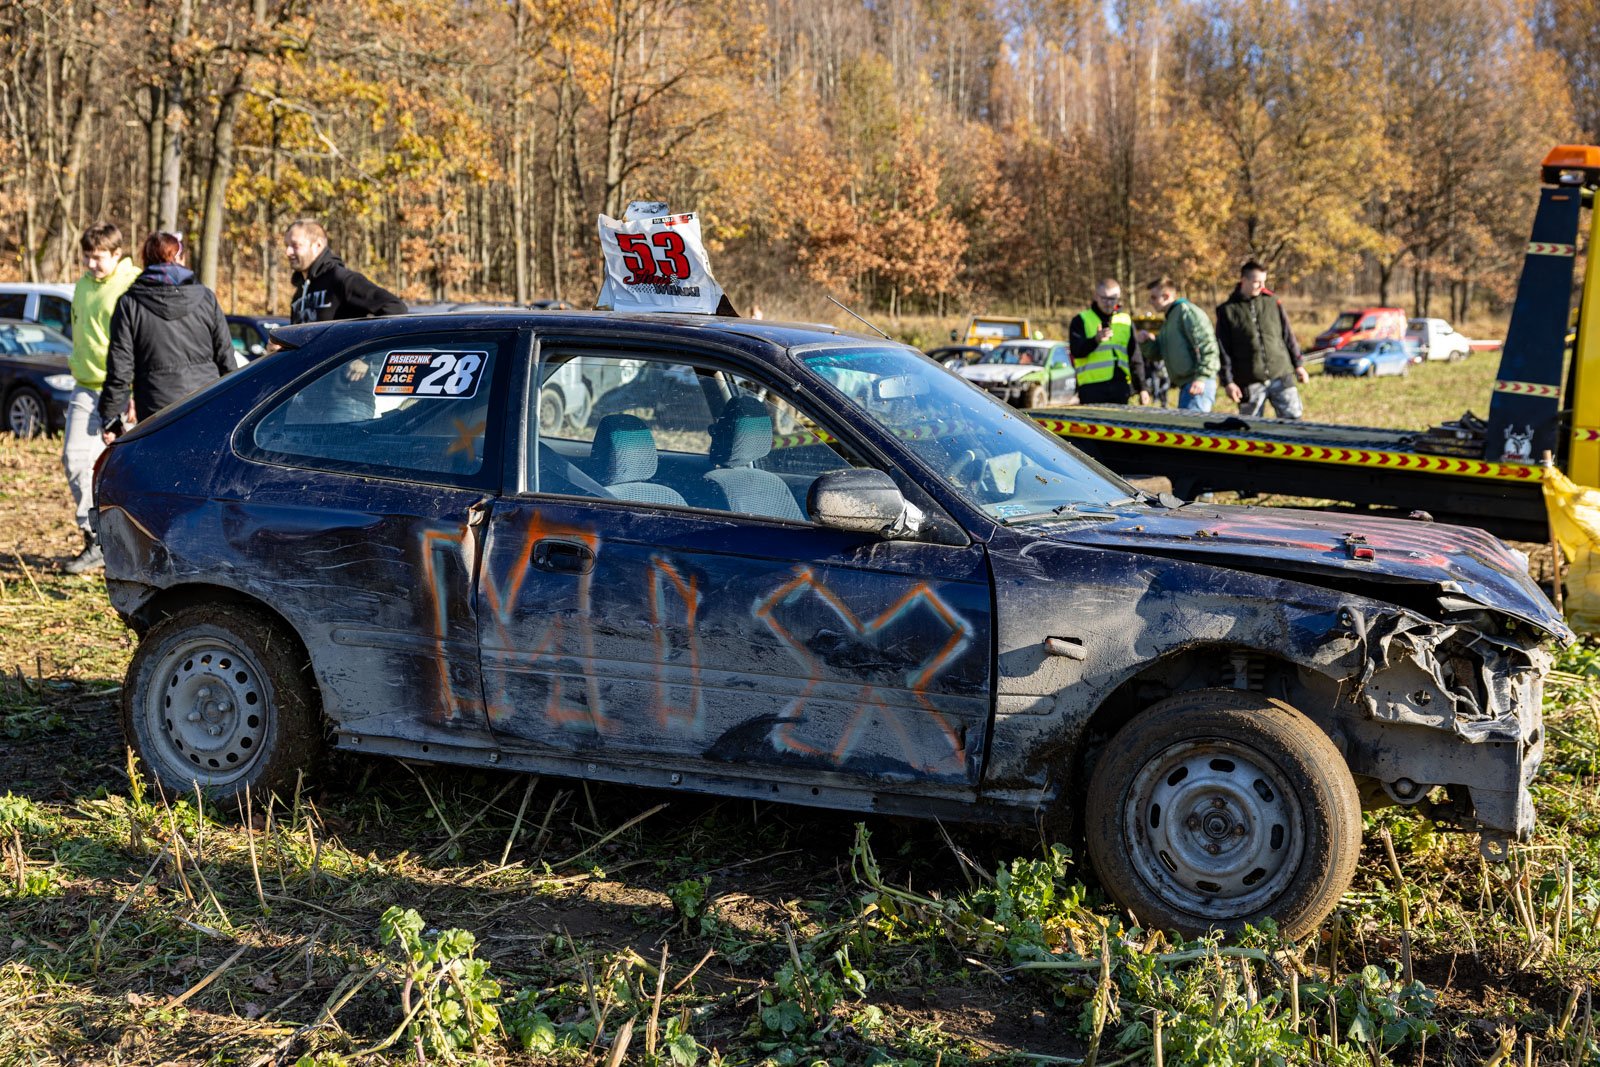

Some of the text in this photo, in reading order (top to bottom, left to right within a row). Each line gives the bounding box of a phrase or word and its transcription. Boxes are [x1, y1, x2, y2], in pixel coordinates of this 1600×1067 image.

[614, 231, 691, 280] 53
[388, 354, 432, 364] PASIECZNIK
[386, 365, 417, 374] WRAK
[415, 354, 481, 395] 28
[382, 374, 414, 383] RACE
